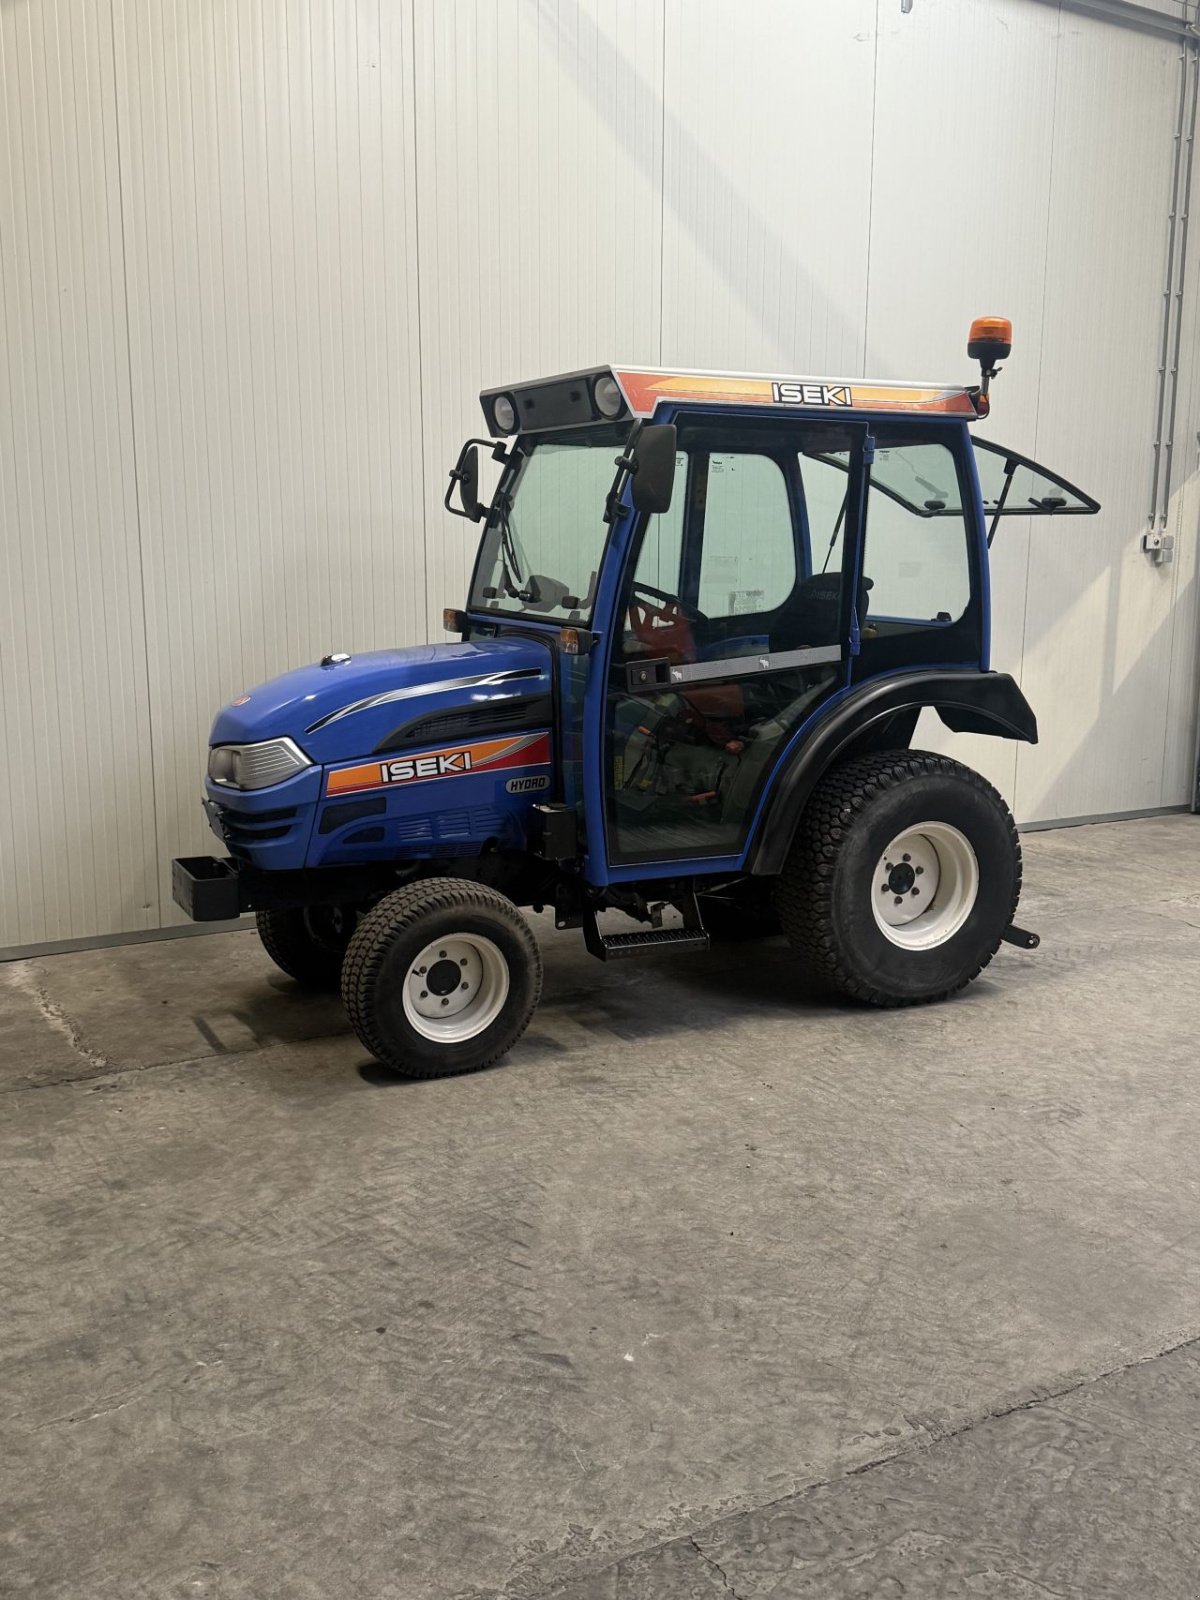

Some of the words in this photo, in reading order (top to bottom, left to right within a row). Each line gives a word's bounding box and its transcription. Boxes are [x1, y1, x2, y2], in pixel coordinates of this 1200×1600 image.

[772, 383, 852, 406] ISEKI
[381, 752, 471, 782] ISEKI
[510, 777, 546, 791] HYDRO
